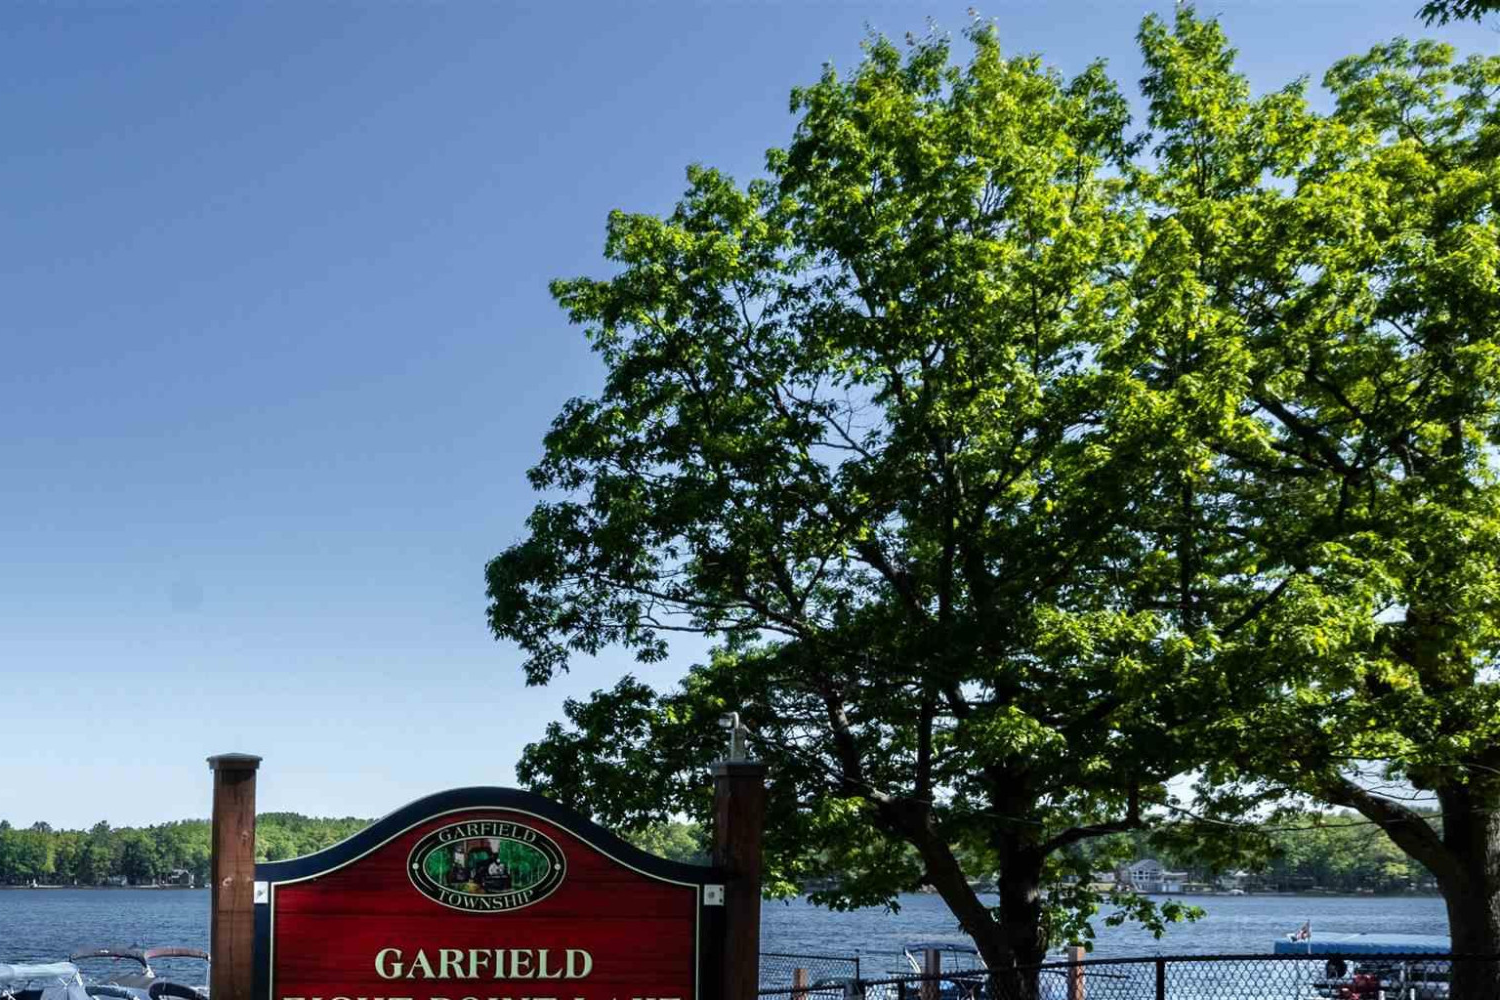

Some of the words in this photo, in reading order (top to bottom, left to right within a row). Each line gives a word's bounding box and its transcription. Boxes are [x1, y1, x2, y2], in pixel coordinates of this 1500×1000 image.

[438, 822, 537, 844] GARFIELD
[438, 888, 534, 910] TOWNSHIP
[374, 947, 593, 979] GARFIELD
